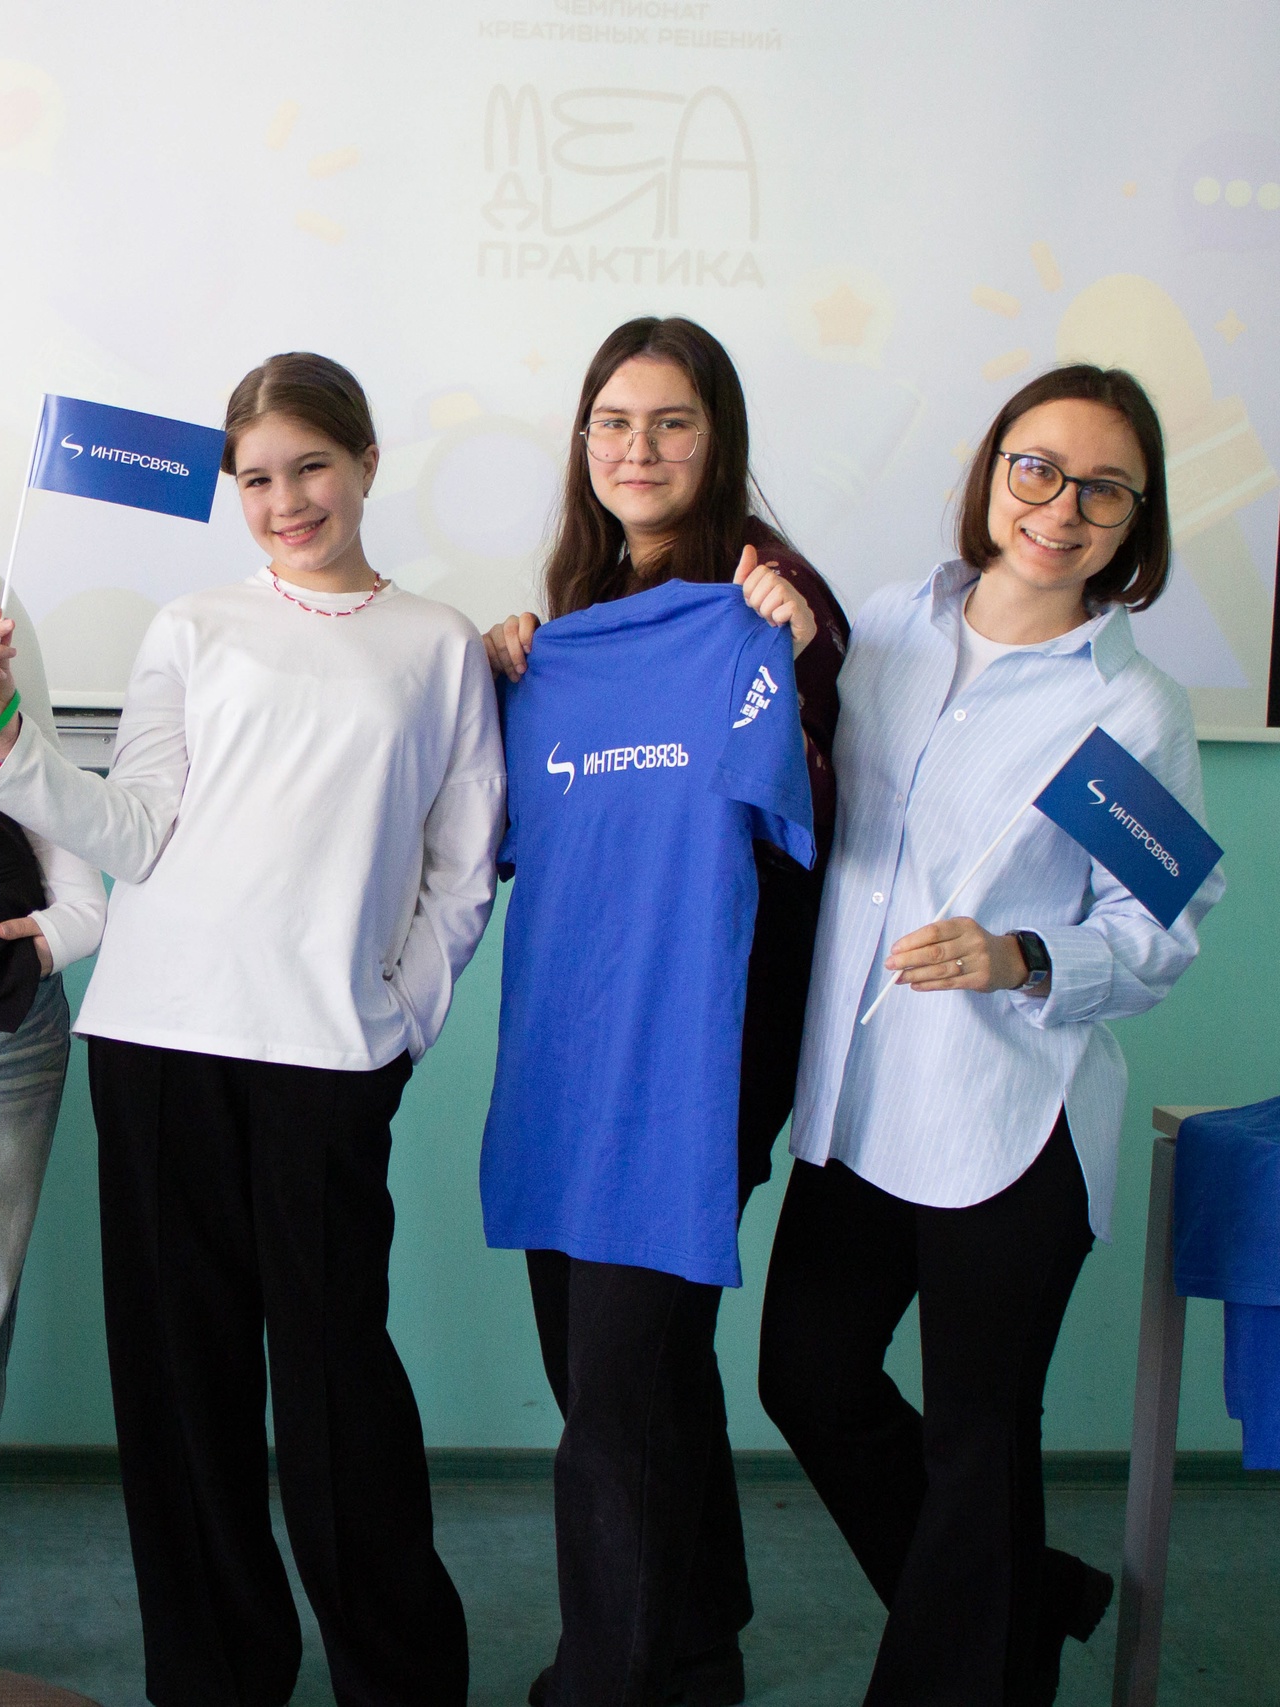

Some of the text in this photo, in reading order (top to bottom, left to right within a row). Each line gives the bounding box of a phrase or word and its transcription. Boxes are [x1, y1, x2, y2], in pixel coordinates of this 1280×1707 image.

[554, 0, 708, 20] ЧЕМПИОНАТ
[477, 20, 783, 51] КРЕАТИВНЫХ РЕШЕНИЙ
[476, 240, 766, 289] ПРАКТИКА
[90, 444, 190, 477] ИНТЕРСВЯЗЬ
[583, 743, 690, 776] ИНТЕРСВЯЗЬ
[1108, 802, 1181, 877] ИНТЕРСВЯЗЬ
